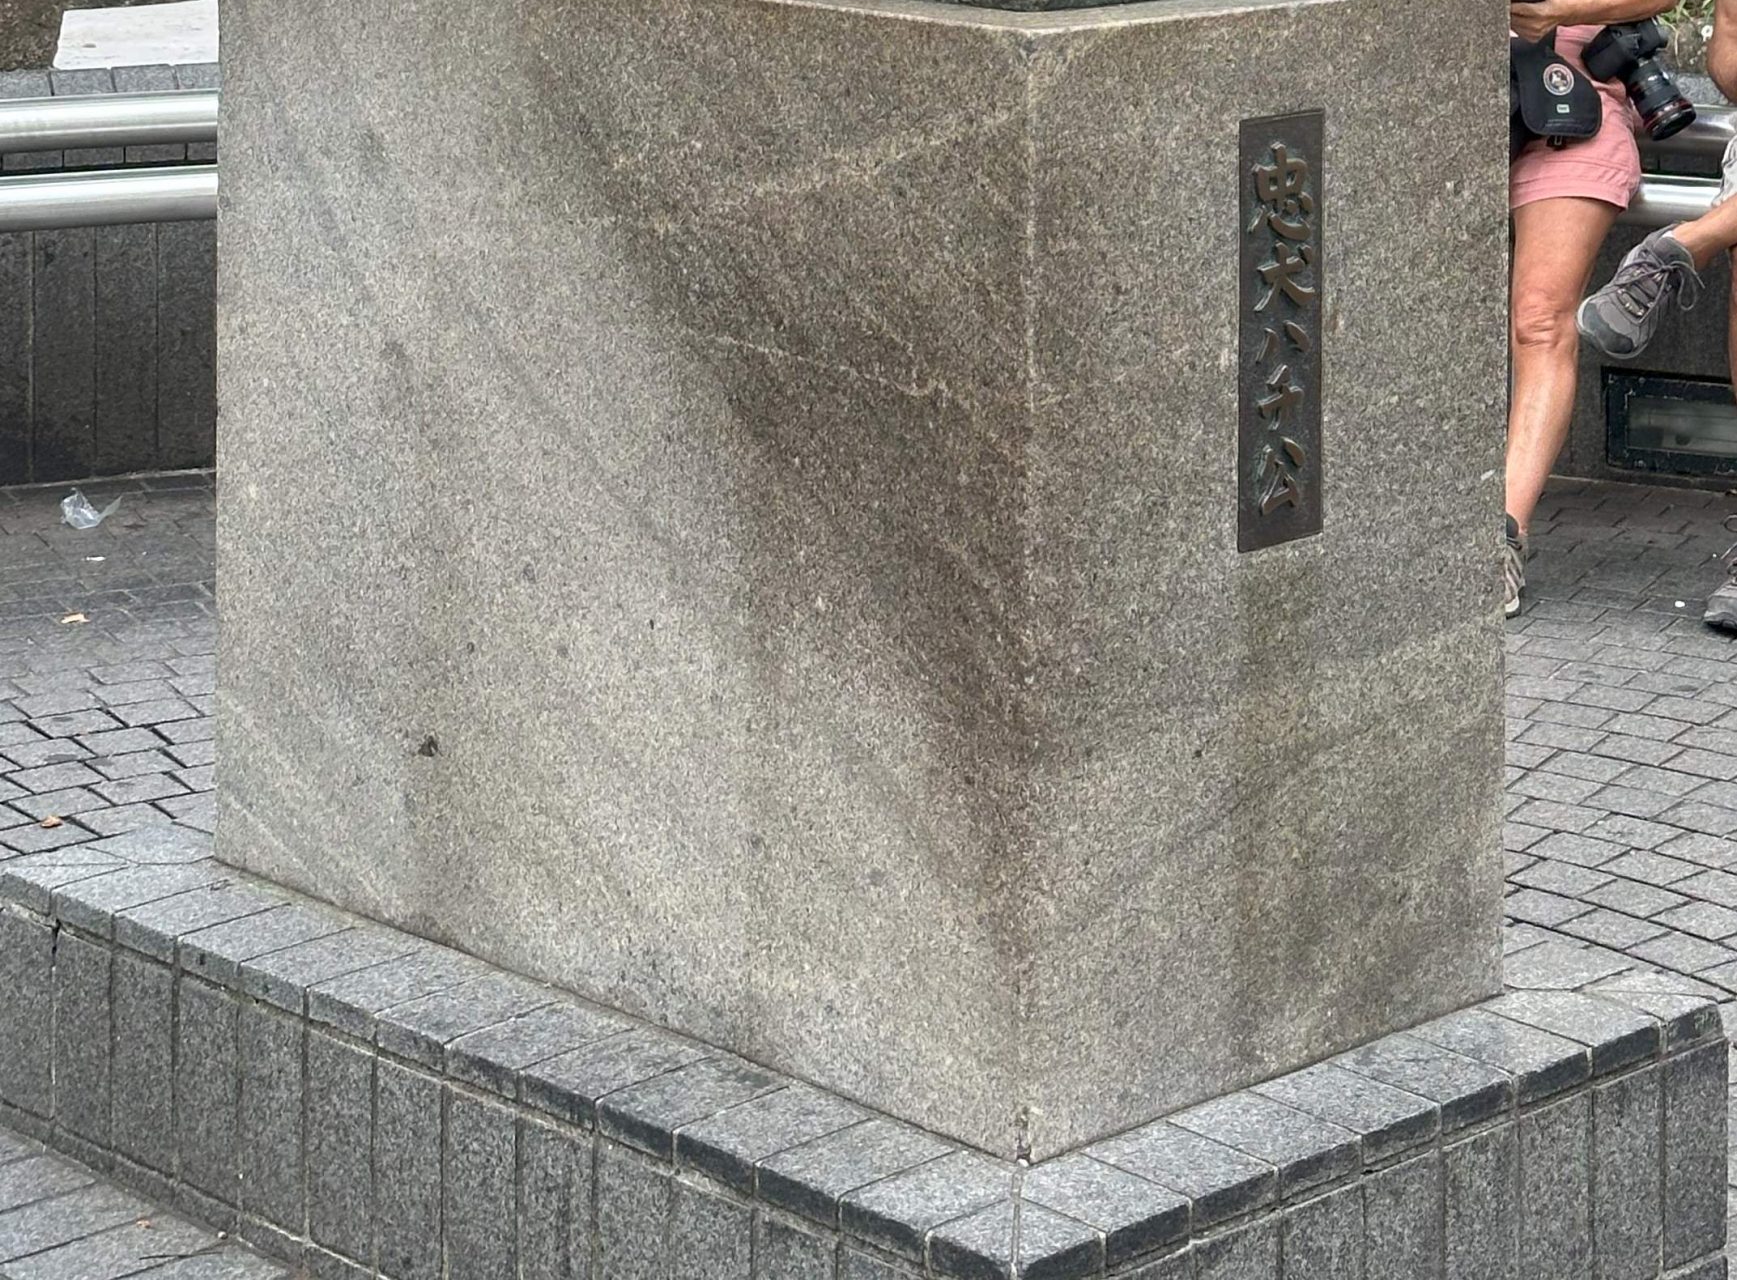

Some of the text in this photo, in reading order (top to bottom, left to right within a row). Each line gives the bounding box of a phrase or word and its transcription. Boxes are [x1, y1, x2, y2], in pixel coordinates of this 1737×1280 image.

[1247, 141, 1315, 517] 忠犬ハチ公
